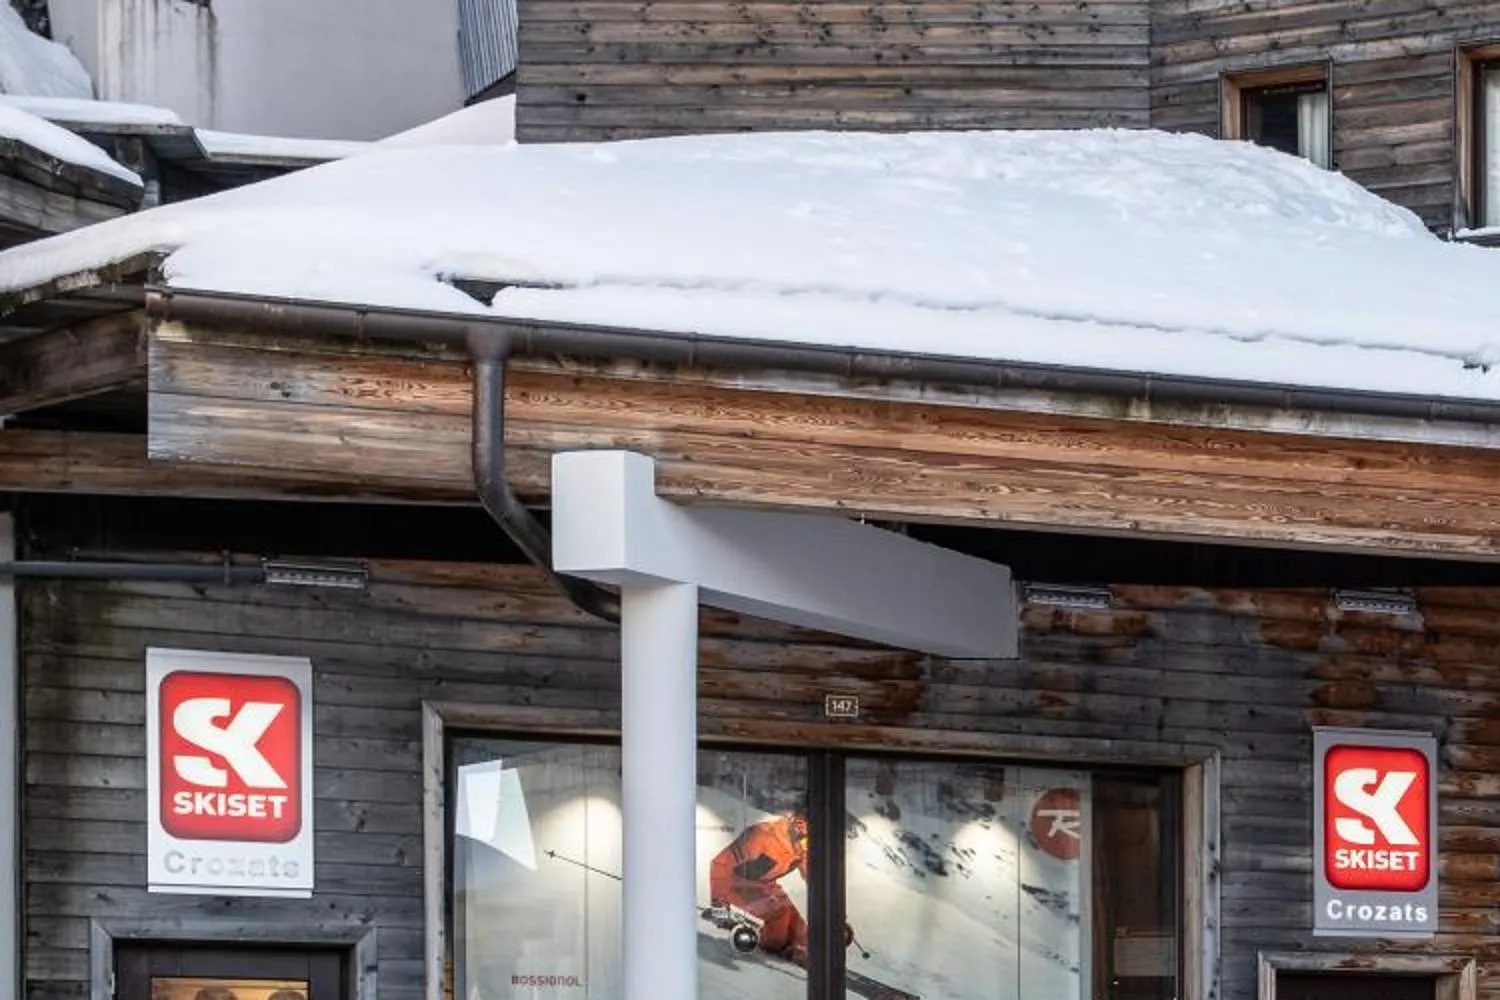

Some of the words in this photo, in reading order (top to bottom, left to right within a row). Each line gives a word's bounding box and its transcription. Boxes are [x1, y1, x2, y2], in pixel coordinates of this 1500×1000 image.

[172, 790, 289, 820] SKISET
[163, 849, 301, 879] Crozats
[1334, 849, 1421, 872] SKISET
[1325, 898, 1430, 922] Crozats
